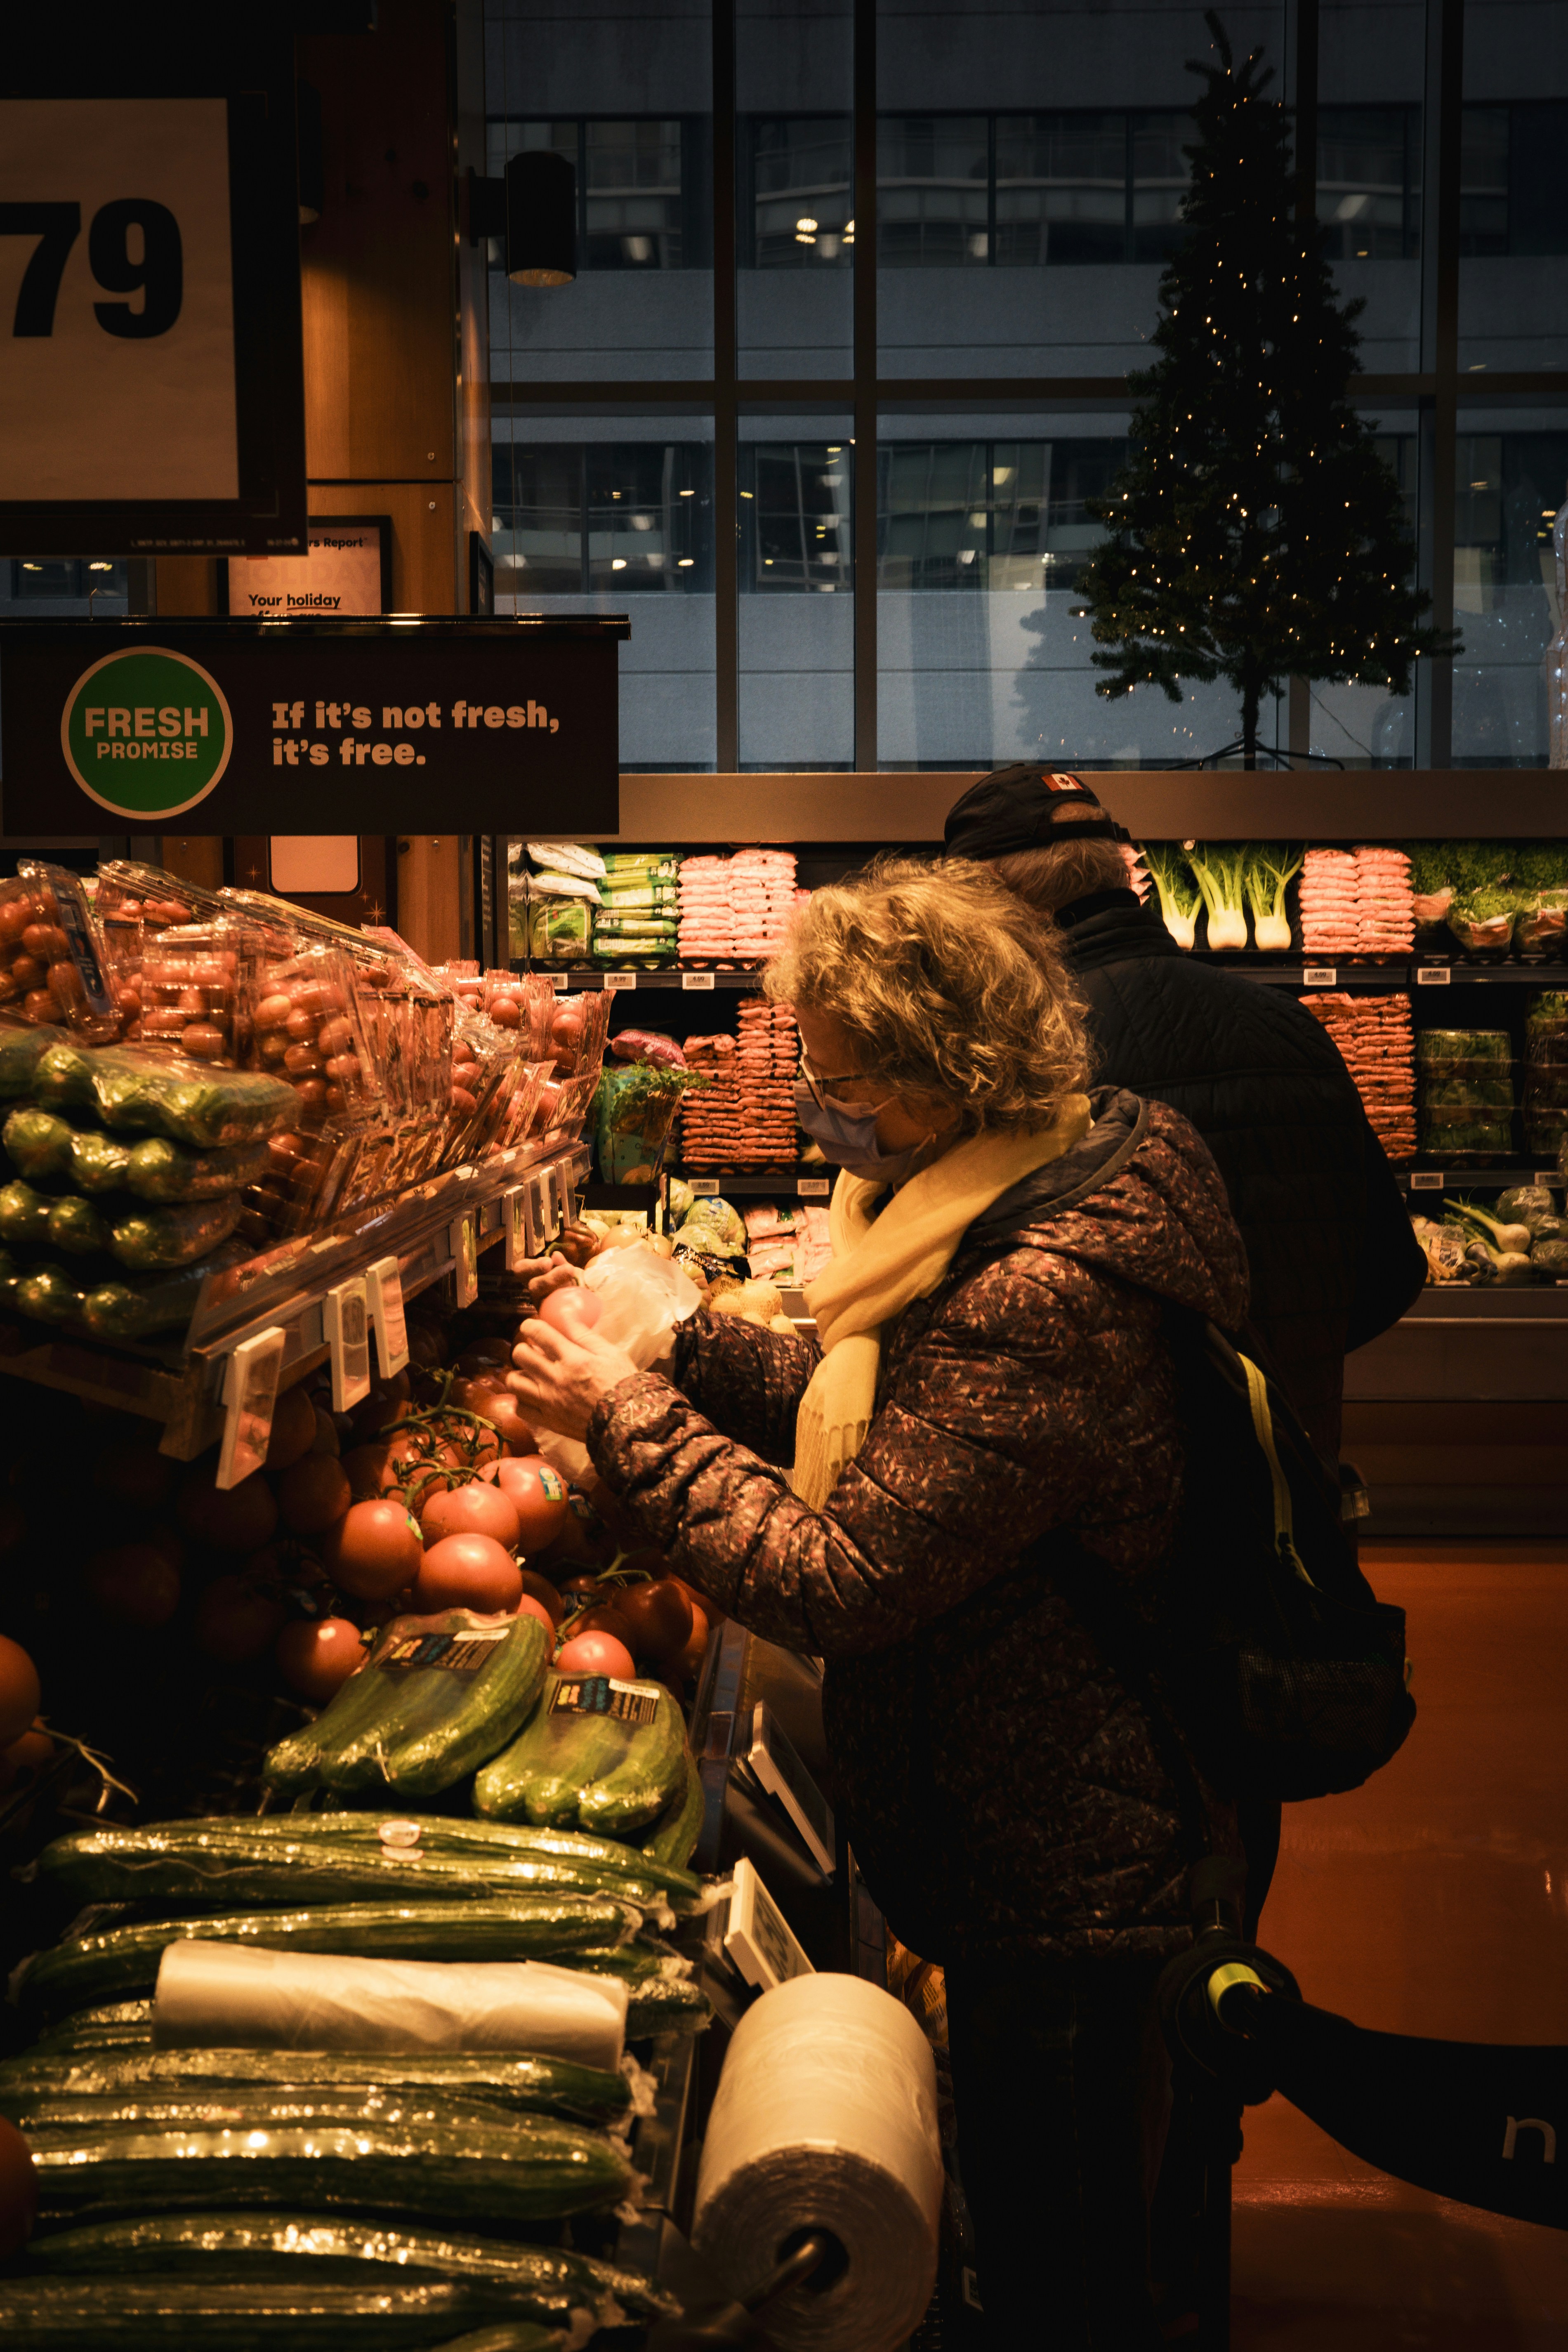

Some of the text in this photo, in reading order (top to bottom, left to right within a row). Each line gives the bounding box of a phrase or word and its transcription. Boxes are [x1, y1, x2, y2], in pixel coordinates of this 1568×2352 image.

[0, 198, 183, 339] 79
[249, 594, 283, 606] Your
[287, 593, 341, 609] holiday
[85, 707, 208, 737] FRESH
[272, 700, 559, 734] If it’s not fresh,
[97, 741, 198, 759] PROMISE
[273, 737, 426, 765] it’s free.
[1502, 2115, 1556, 2164] n
